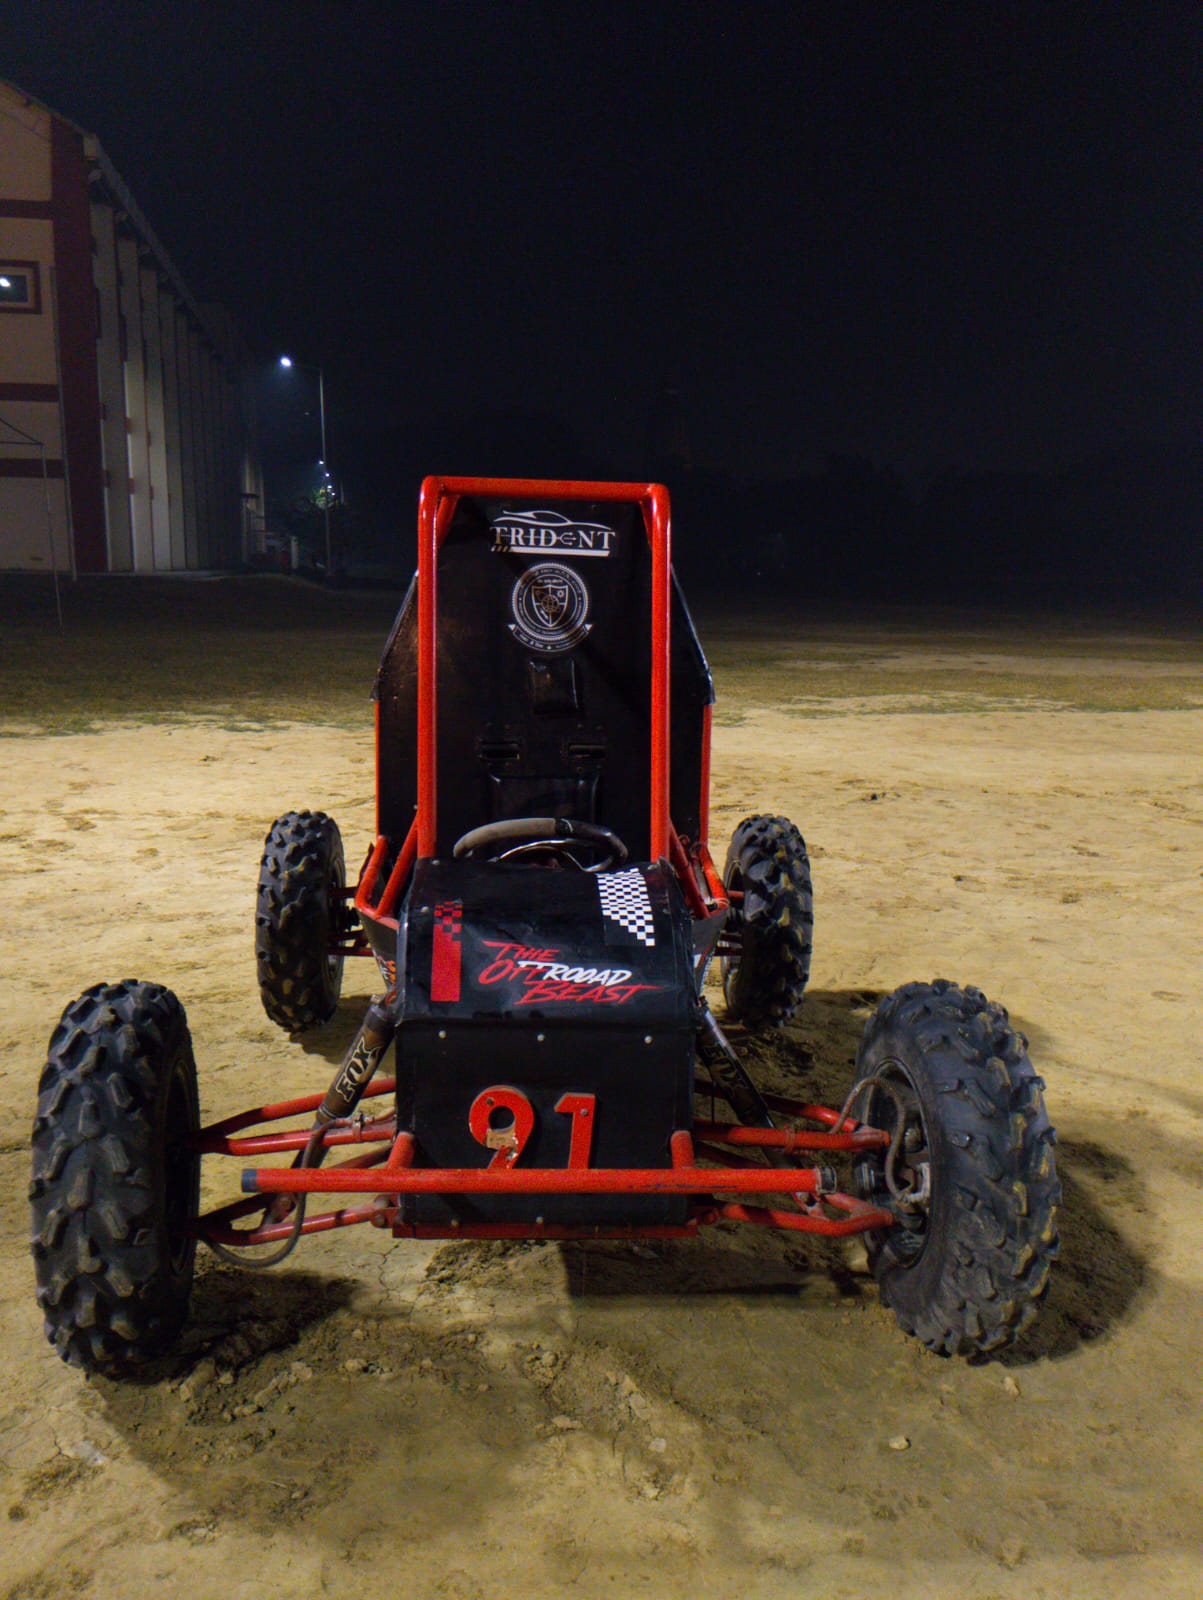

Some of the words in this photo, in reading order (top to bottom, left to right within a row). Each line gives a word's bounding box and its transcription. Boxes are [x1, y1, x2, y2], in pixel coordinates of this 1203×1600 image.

[489, 526, 616, 550] TRIDENT
[514, 980, 664, 1005] BEAST
[336, 1036, 380, 1103] FOX
[468, 1084, 596, 1170] 91
